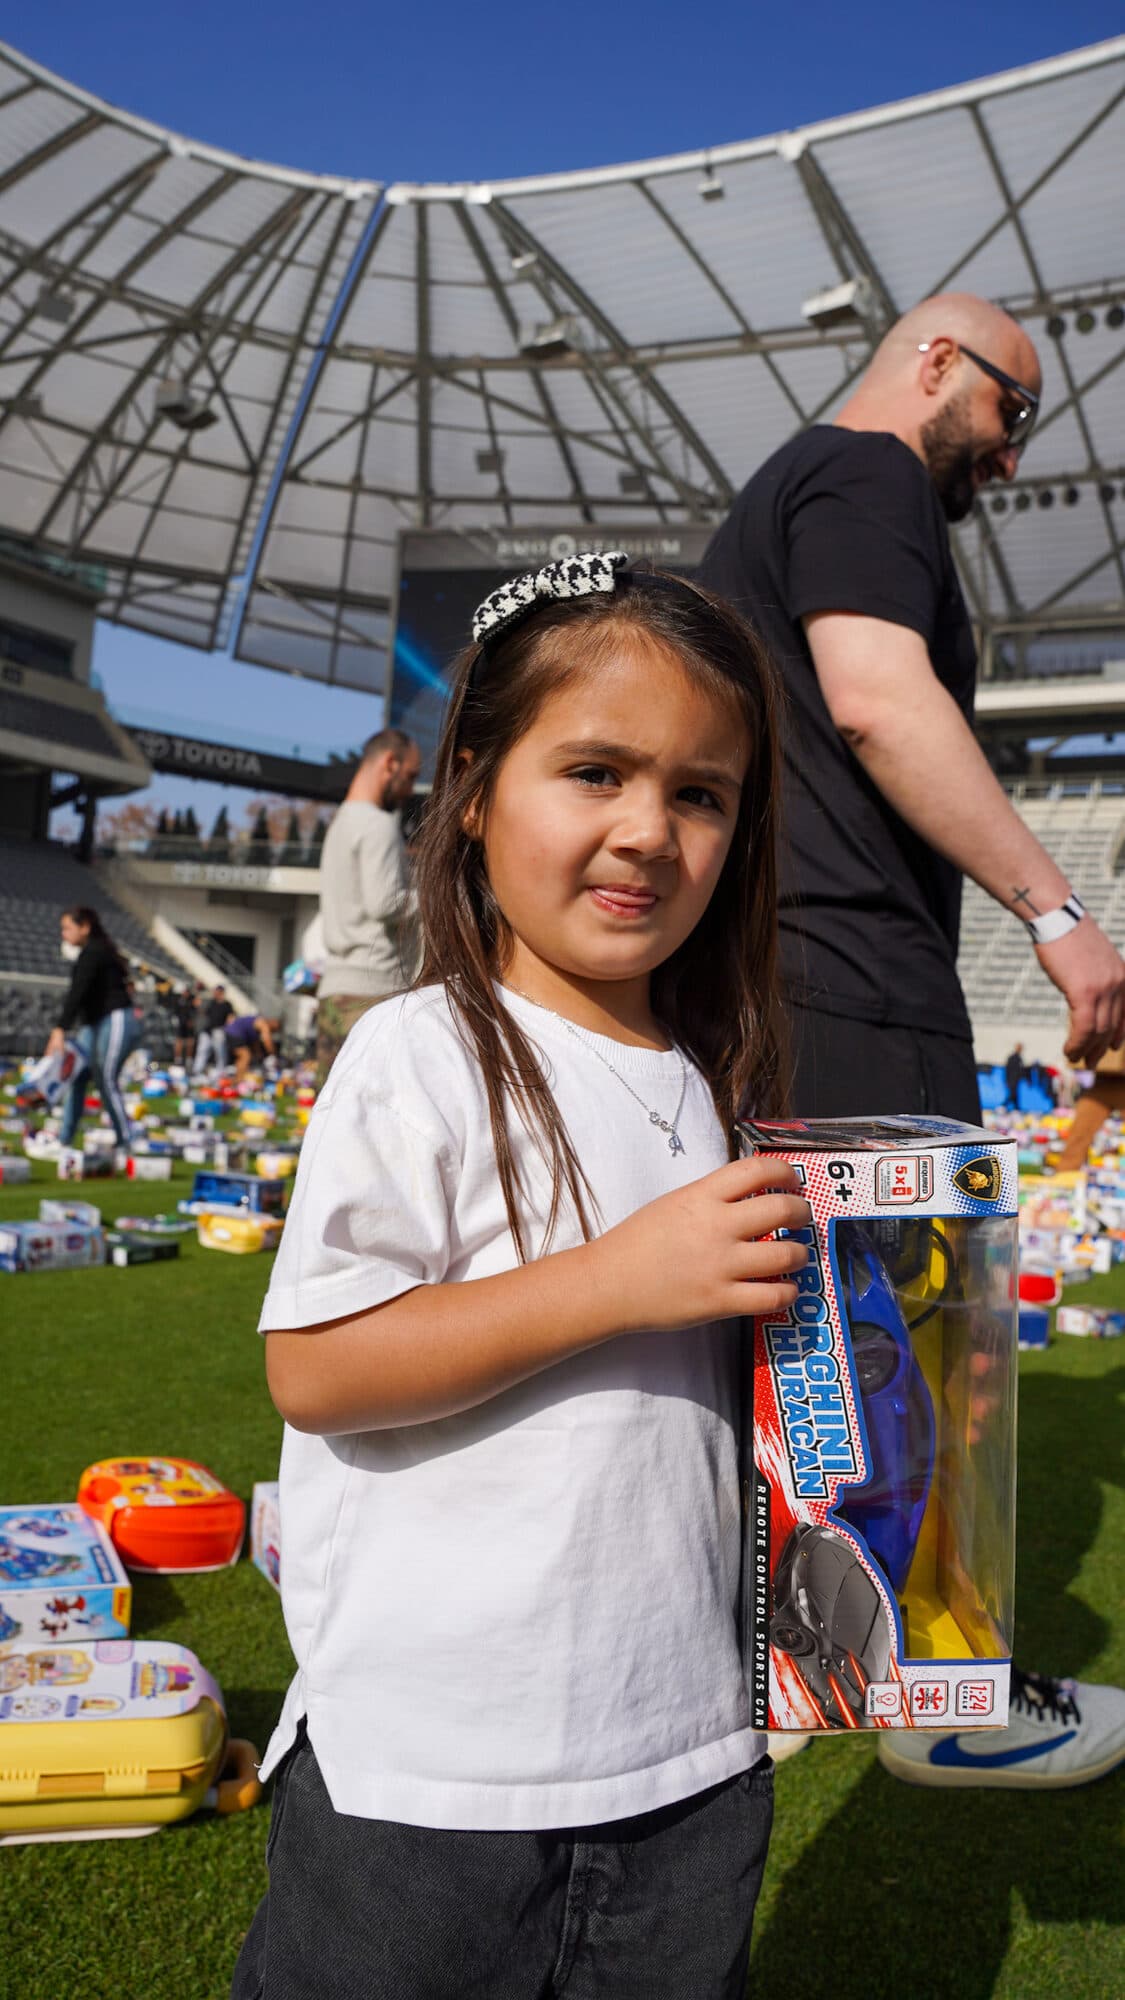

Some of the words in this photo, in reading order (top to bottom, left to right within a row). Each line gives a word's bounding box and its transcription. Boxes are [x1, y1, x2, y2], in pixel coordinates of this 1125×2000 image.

[173, 739, 262, 775] TOYOTA
[205, 865, 282, 885] TOYOTA
[827, 1160, 855, 1202] 6+
[771, 1329, 824, 1494] HURACAN
[757, 1485, 767, 1548] REMOTE
[756, 1554, 766, 1624] CONTROL
[755, 1632, 766, 1690] SPORTS
[755, 1698, 765, 1727] CAR
[969, 1685, 988, 1710] 1:24
